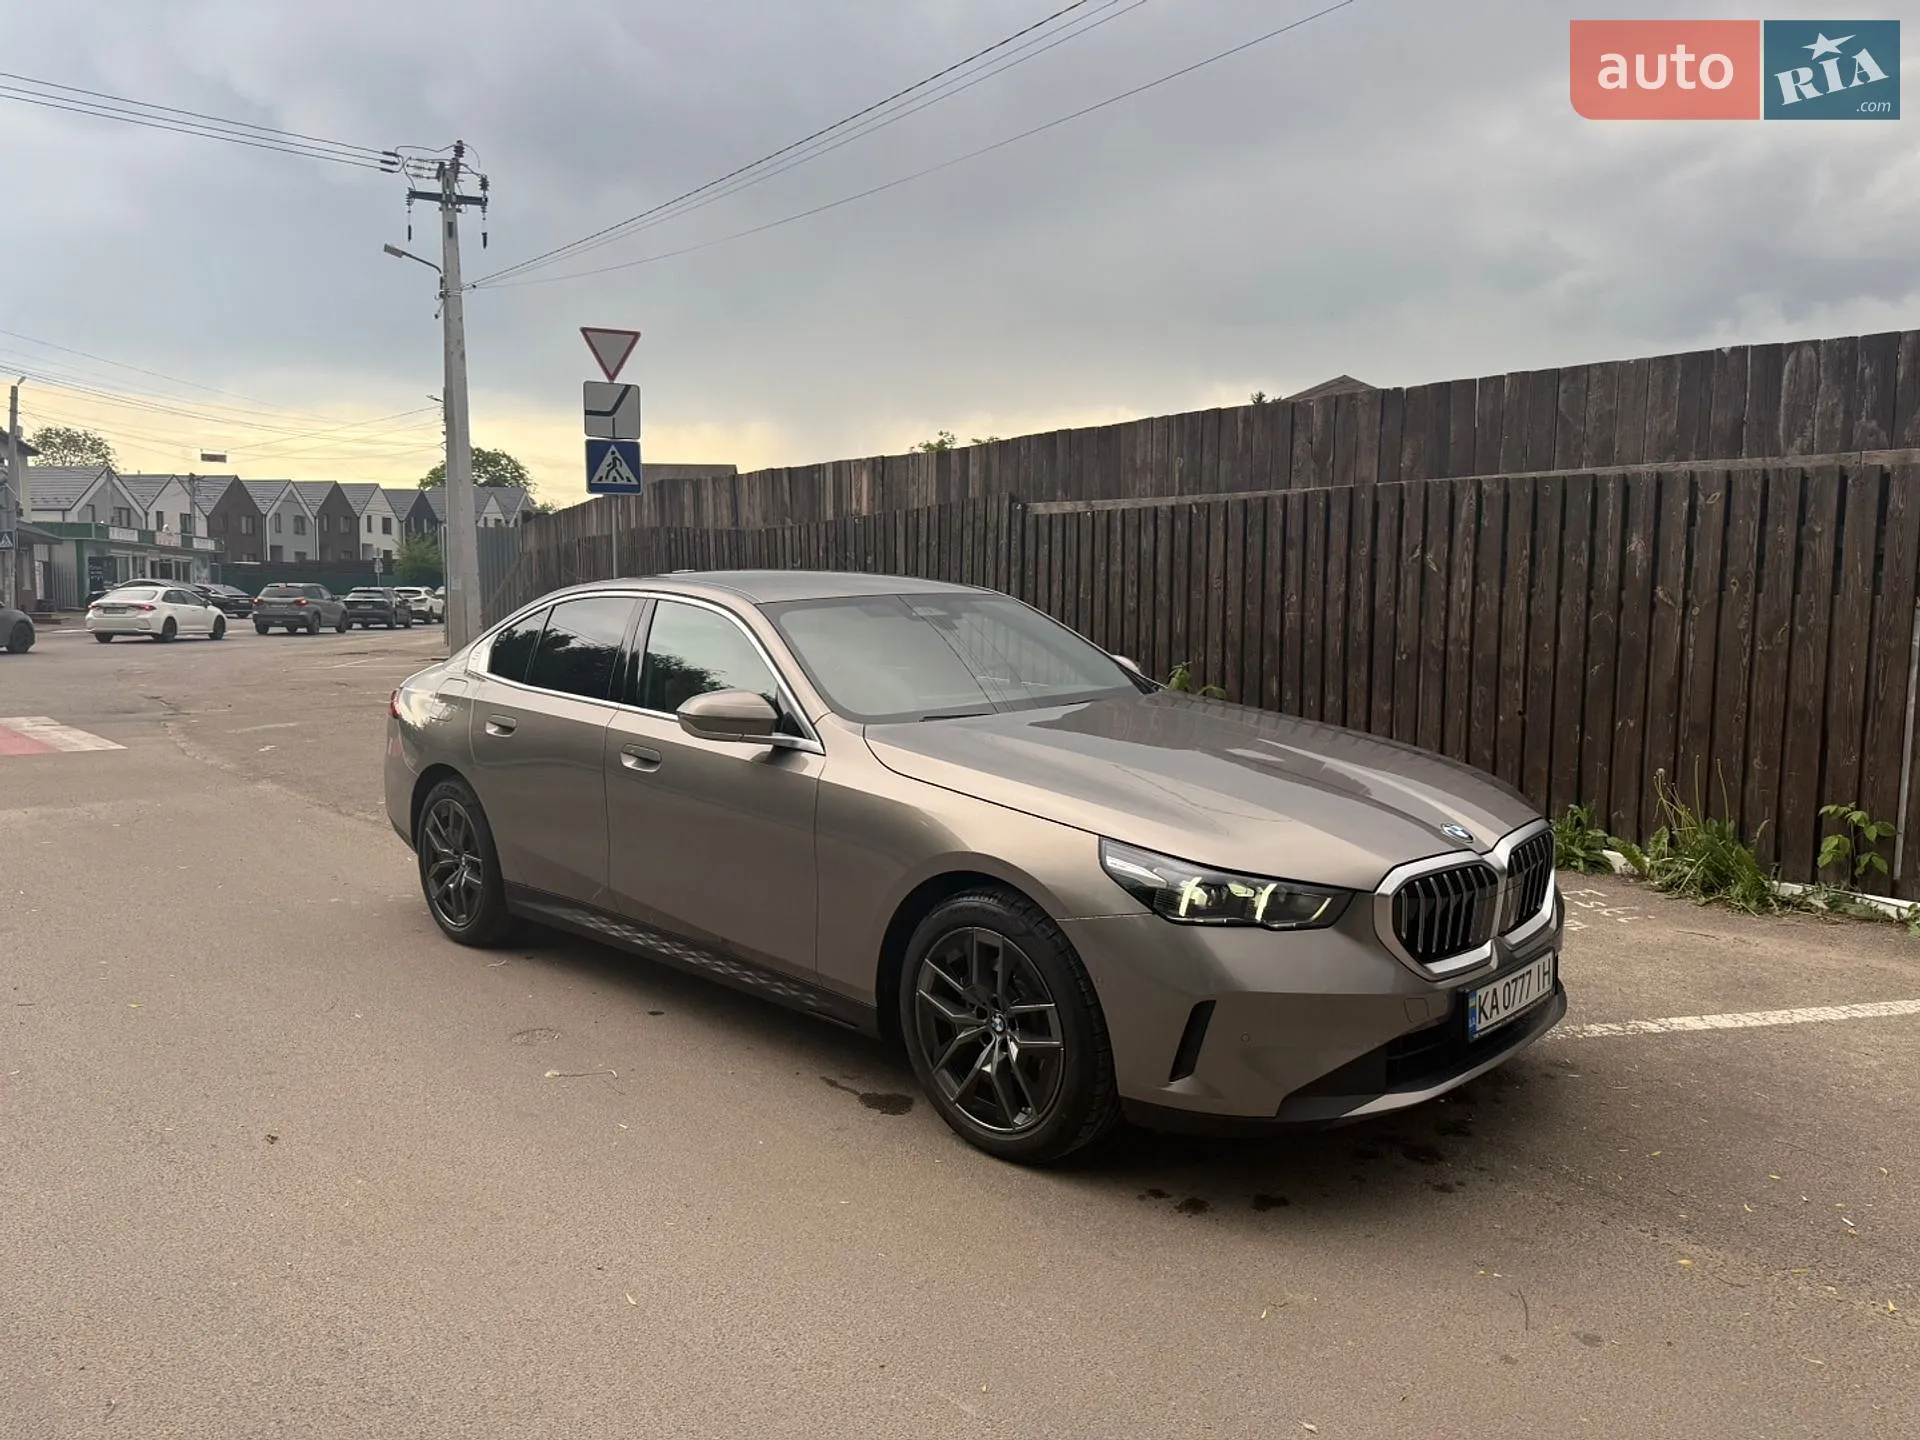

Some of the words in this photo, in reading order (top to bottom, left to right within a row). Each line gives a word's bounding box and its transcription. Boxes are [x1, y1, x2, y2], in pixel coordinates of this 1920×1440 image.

[1478, 988, 1499, 1025] KA
[1503, 969, 1532, 1010] 0777
[1537, 958, 1551, 993] IH
